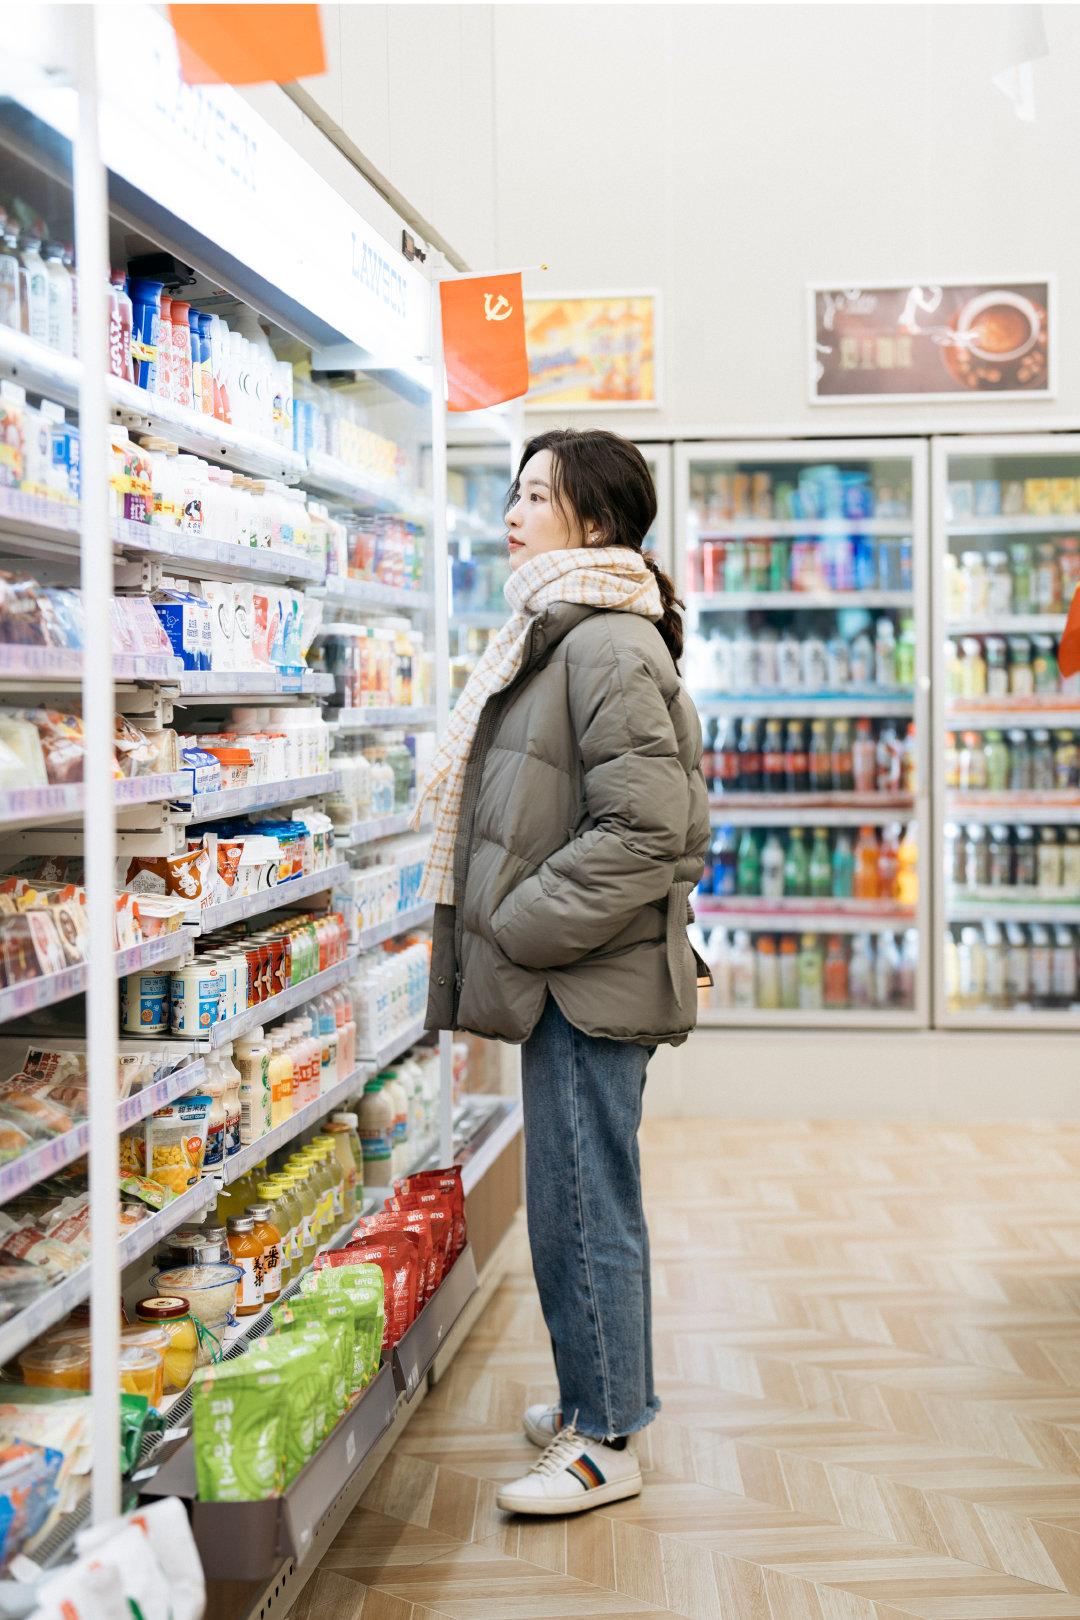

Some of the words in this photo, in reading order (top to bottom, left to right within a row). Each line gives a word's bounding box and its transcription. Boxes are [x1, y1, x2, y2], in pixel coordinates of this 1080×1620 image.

[154, 503, 175, 513] 买一
[178, 1103, 207, 1114] 甜玉米粒
